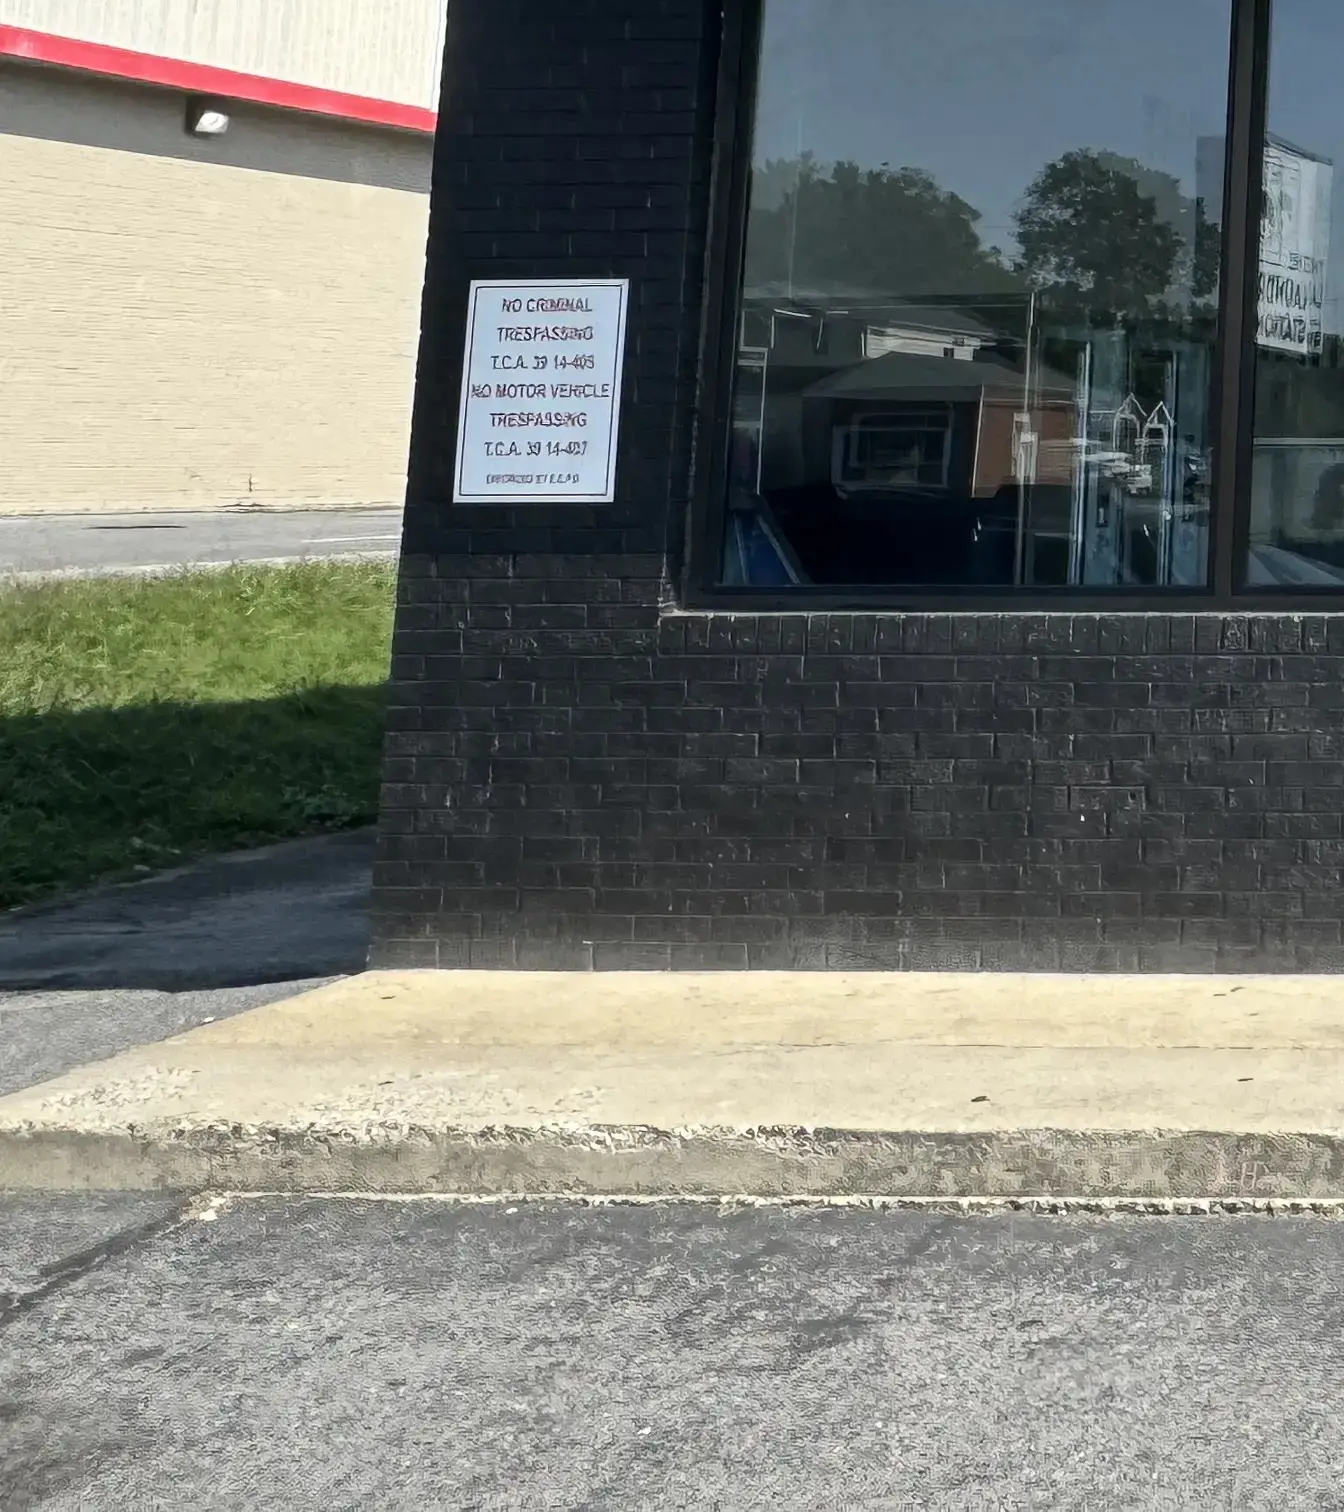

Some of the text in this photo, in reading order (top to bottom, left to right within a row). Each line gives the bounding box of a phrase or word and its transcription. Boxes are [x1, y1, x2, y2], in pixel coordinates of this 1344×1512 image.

[501, 297, 593, 312] NO CRIMINAL
[496, 326, 594, 341] TRESPASSING
[471, 383, 611, 399] NO MOTOR VEHICLE
[489, 412, 588, 428] TRESPASSING
